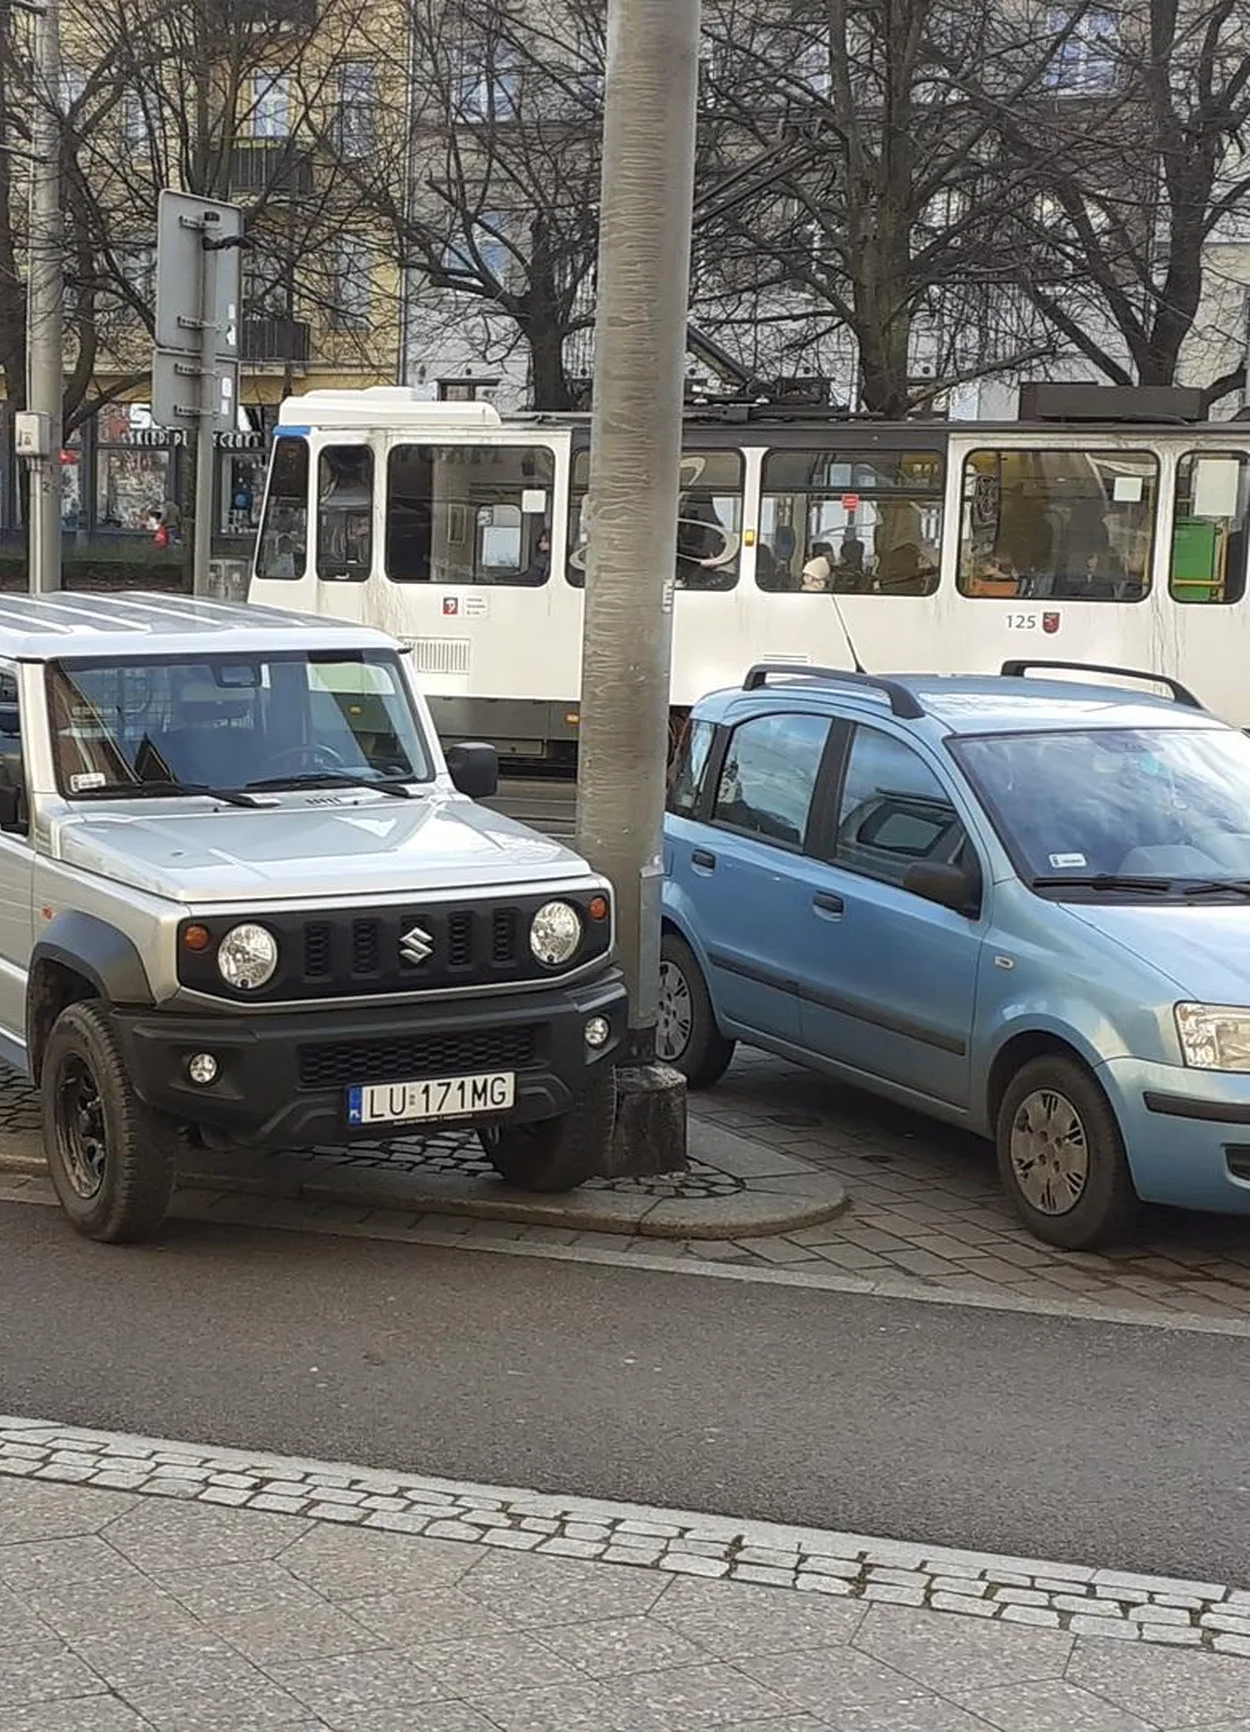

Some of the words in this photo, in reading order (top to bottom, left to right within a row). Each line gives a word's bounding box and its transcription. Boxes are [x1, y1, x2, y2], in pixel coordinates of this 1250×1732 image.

[1006, 614, 1036, 629] 125
[369, 1086, 407, 1119] LU
[421, 1077, 507, 1113] 171MG
